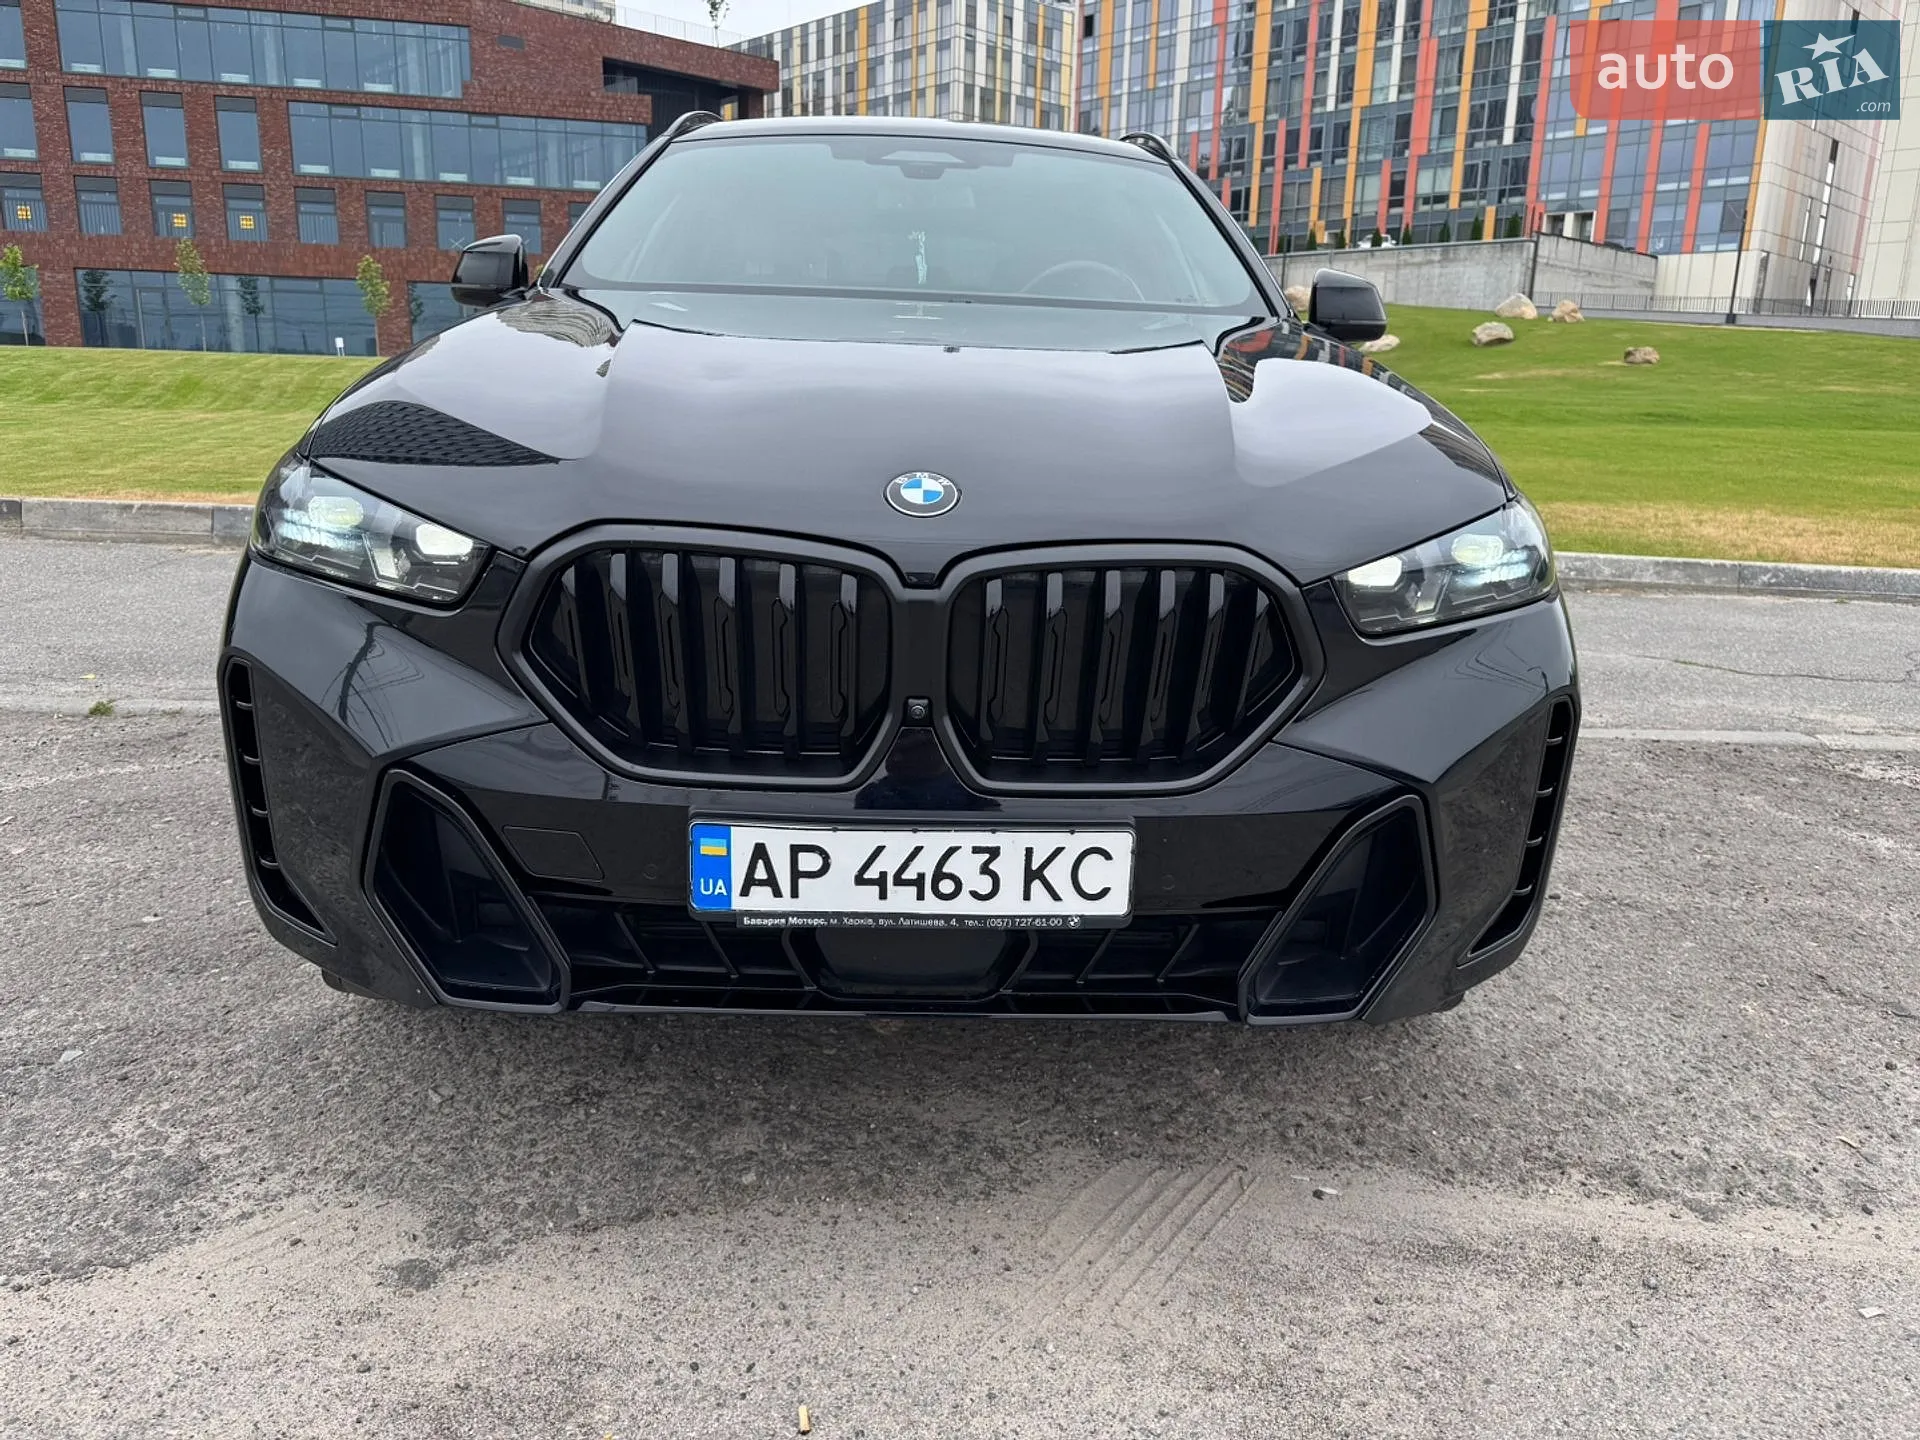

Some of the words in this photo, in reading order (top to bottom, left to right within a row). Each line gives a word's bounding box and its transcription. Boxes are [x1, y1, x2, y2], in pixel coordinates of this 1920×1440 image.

[700, 878, 728, 896] UA
[739, 842, 832, 899] AP
[853, 845, 1001, 901] 4463
[1022, 846, 1114, 902] KC
